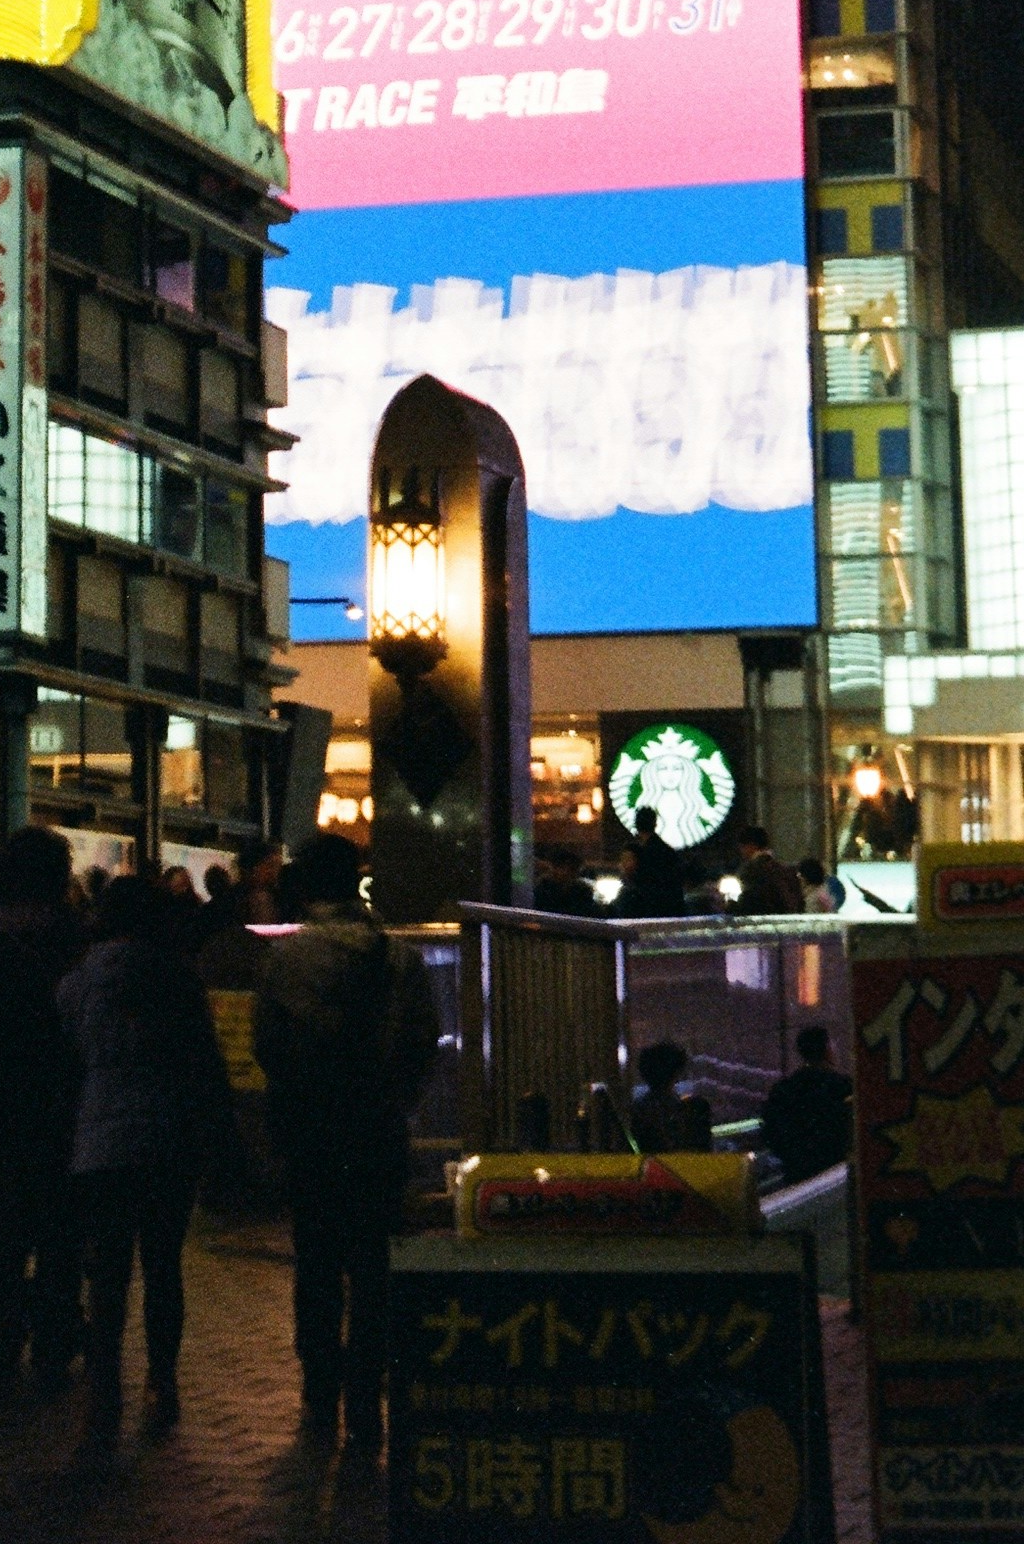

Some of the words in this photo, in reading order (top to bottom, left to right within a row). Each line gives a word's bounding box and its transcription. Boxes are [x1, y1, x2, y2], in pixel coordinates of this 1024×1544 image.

[322, 2, 395, 61] 27
[313, 78, 442, 133] RACE
[421, 1298, 772, 1368] ナイトパック
[413, 1436, 627, 1520] 5時間
